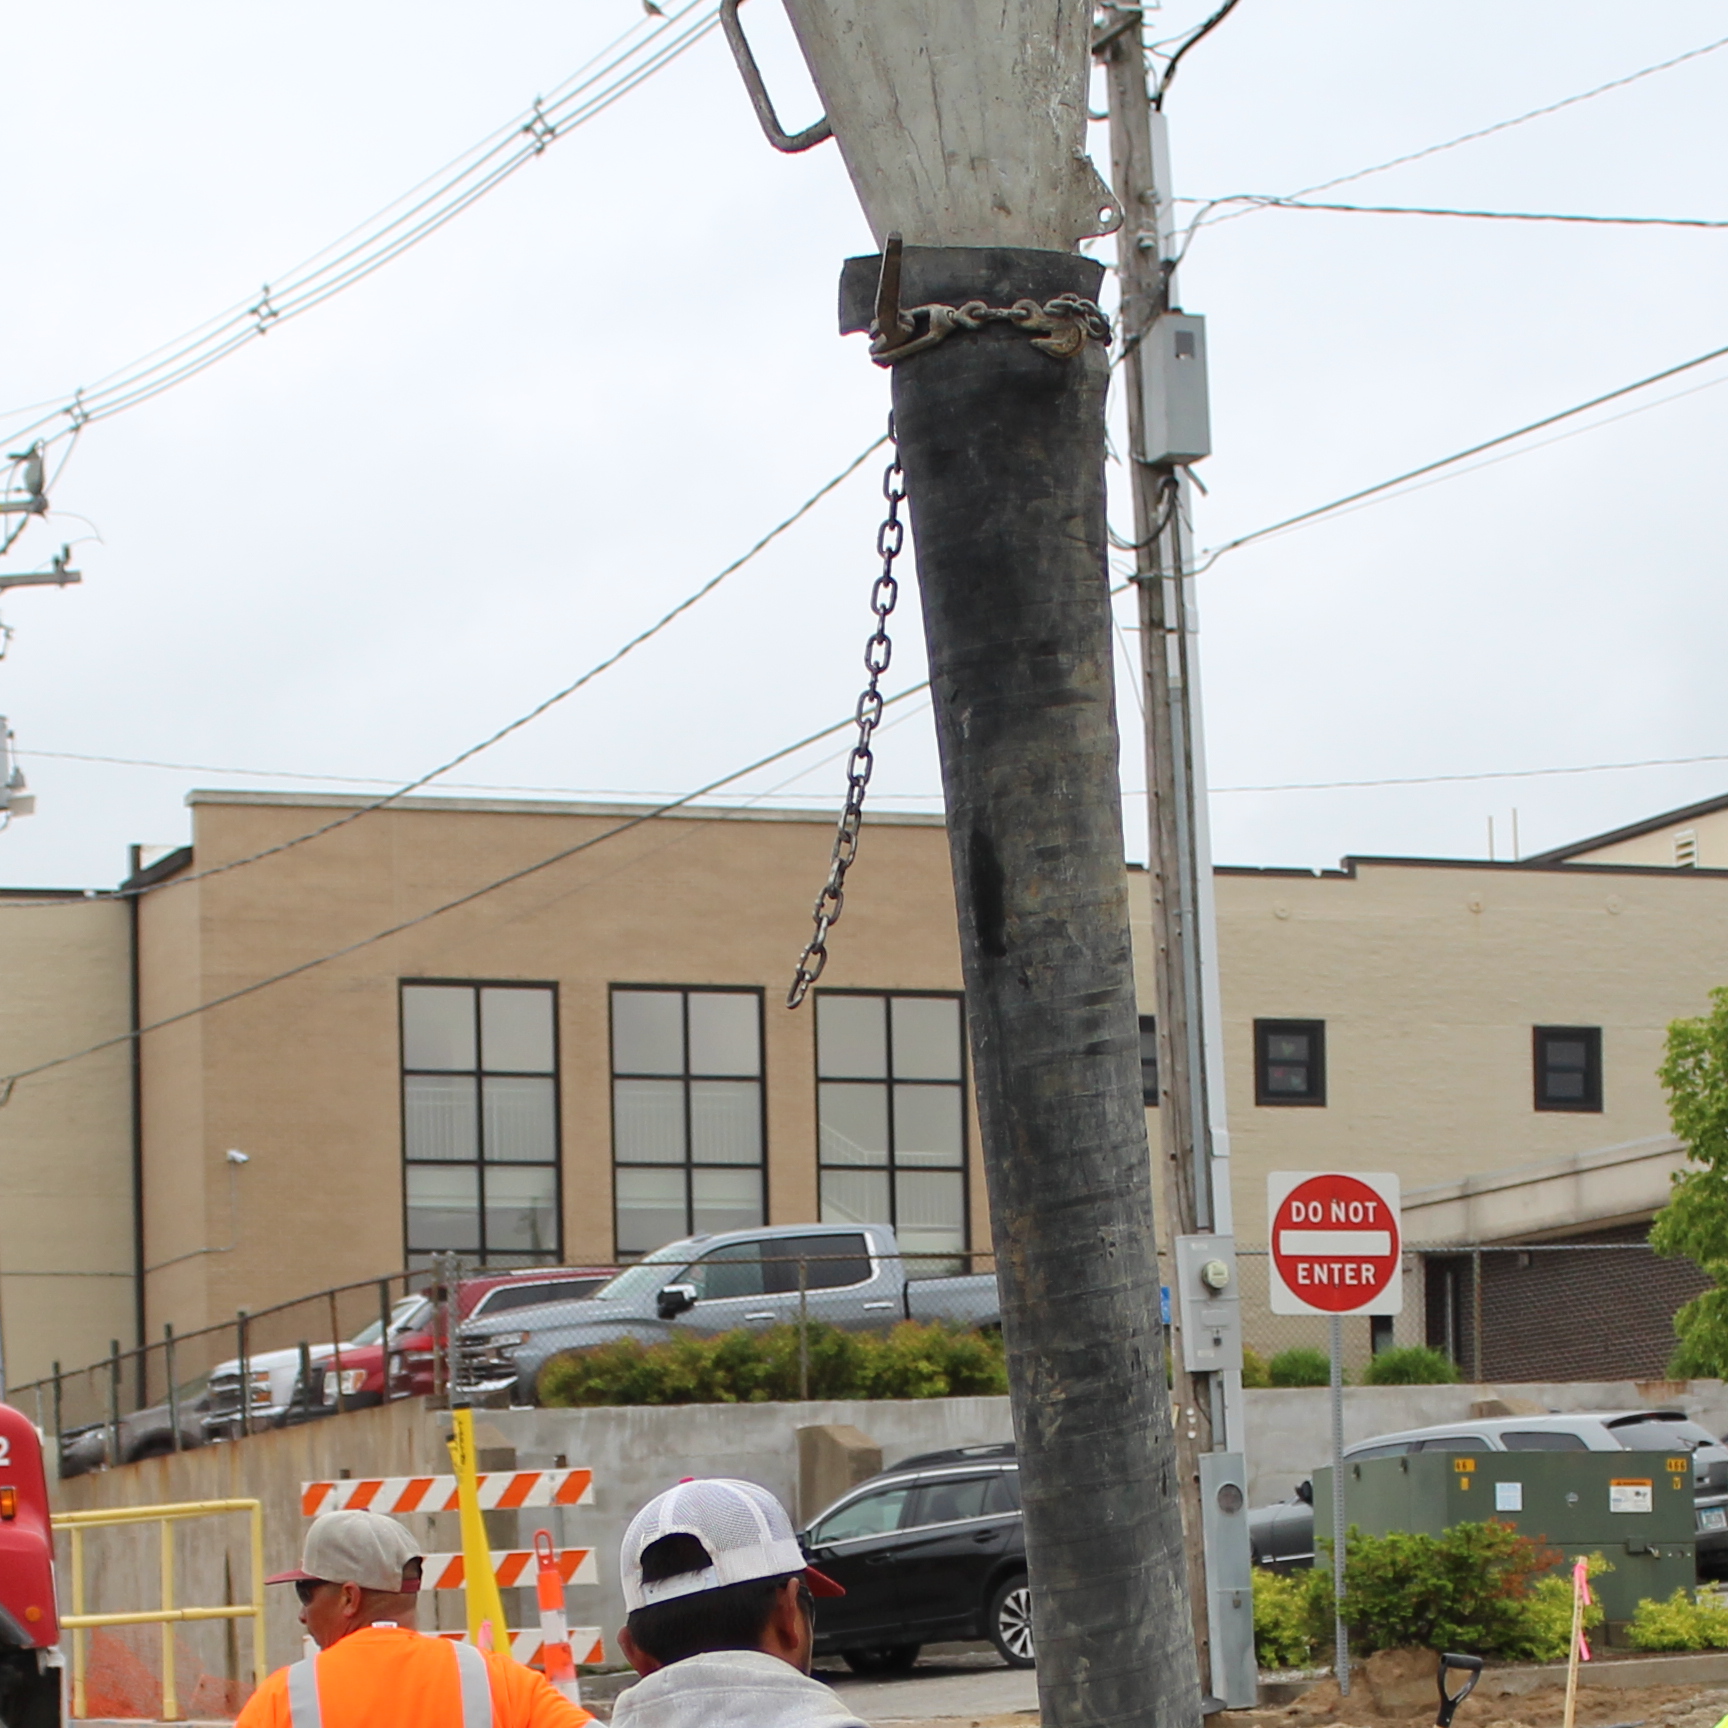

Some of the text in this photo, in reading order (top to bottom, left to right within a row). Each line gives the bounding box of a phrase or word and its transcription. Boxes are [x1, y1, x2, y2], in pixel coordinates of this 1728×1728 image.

[1291, 1201, 1378, 1223] DO NOT
[1296, 1263, 1376, 1285] ENTER
